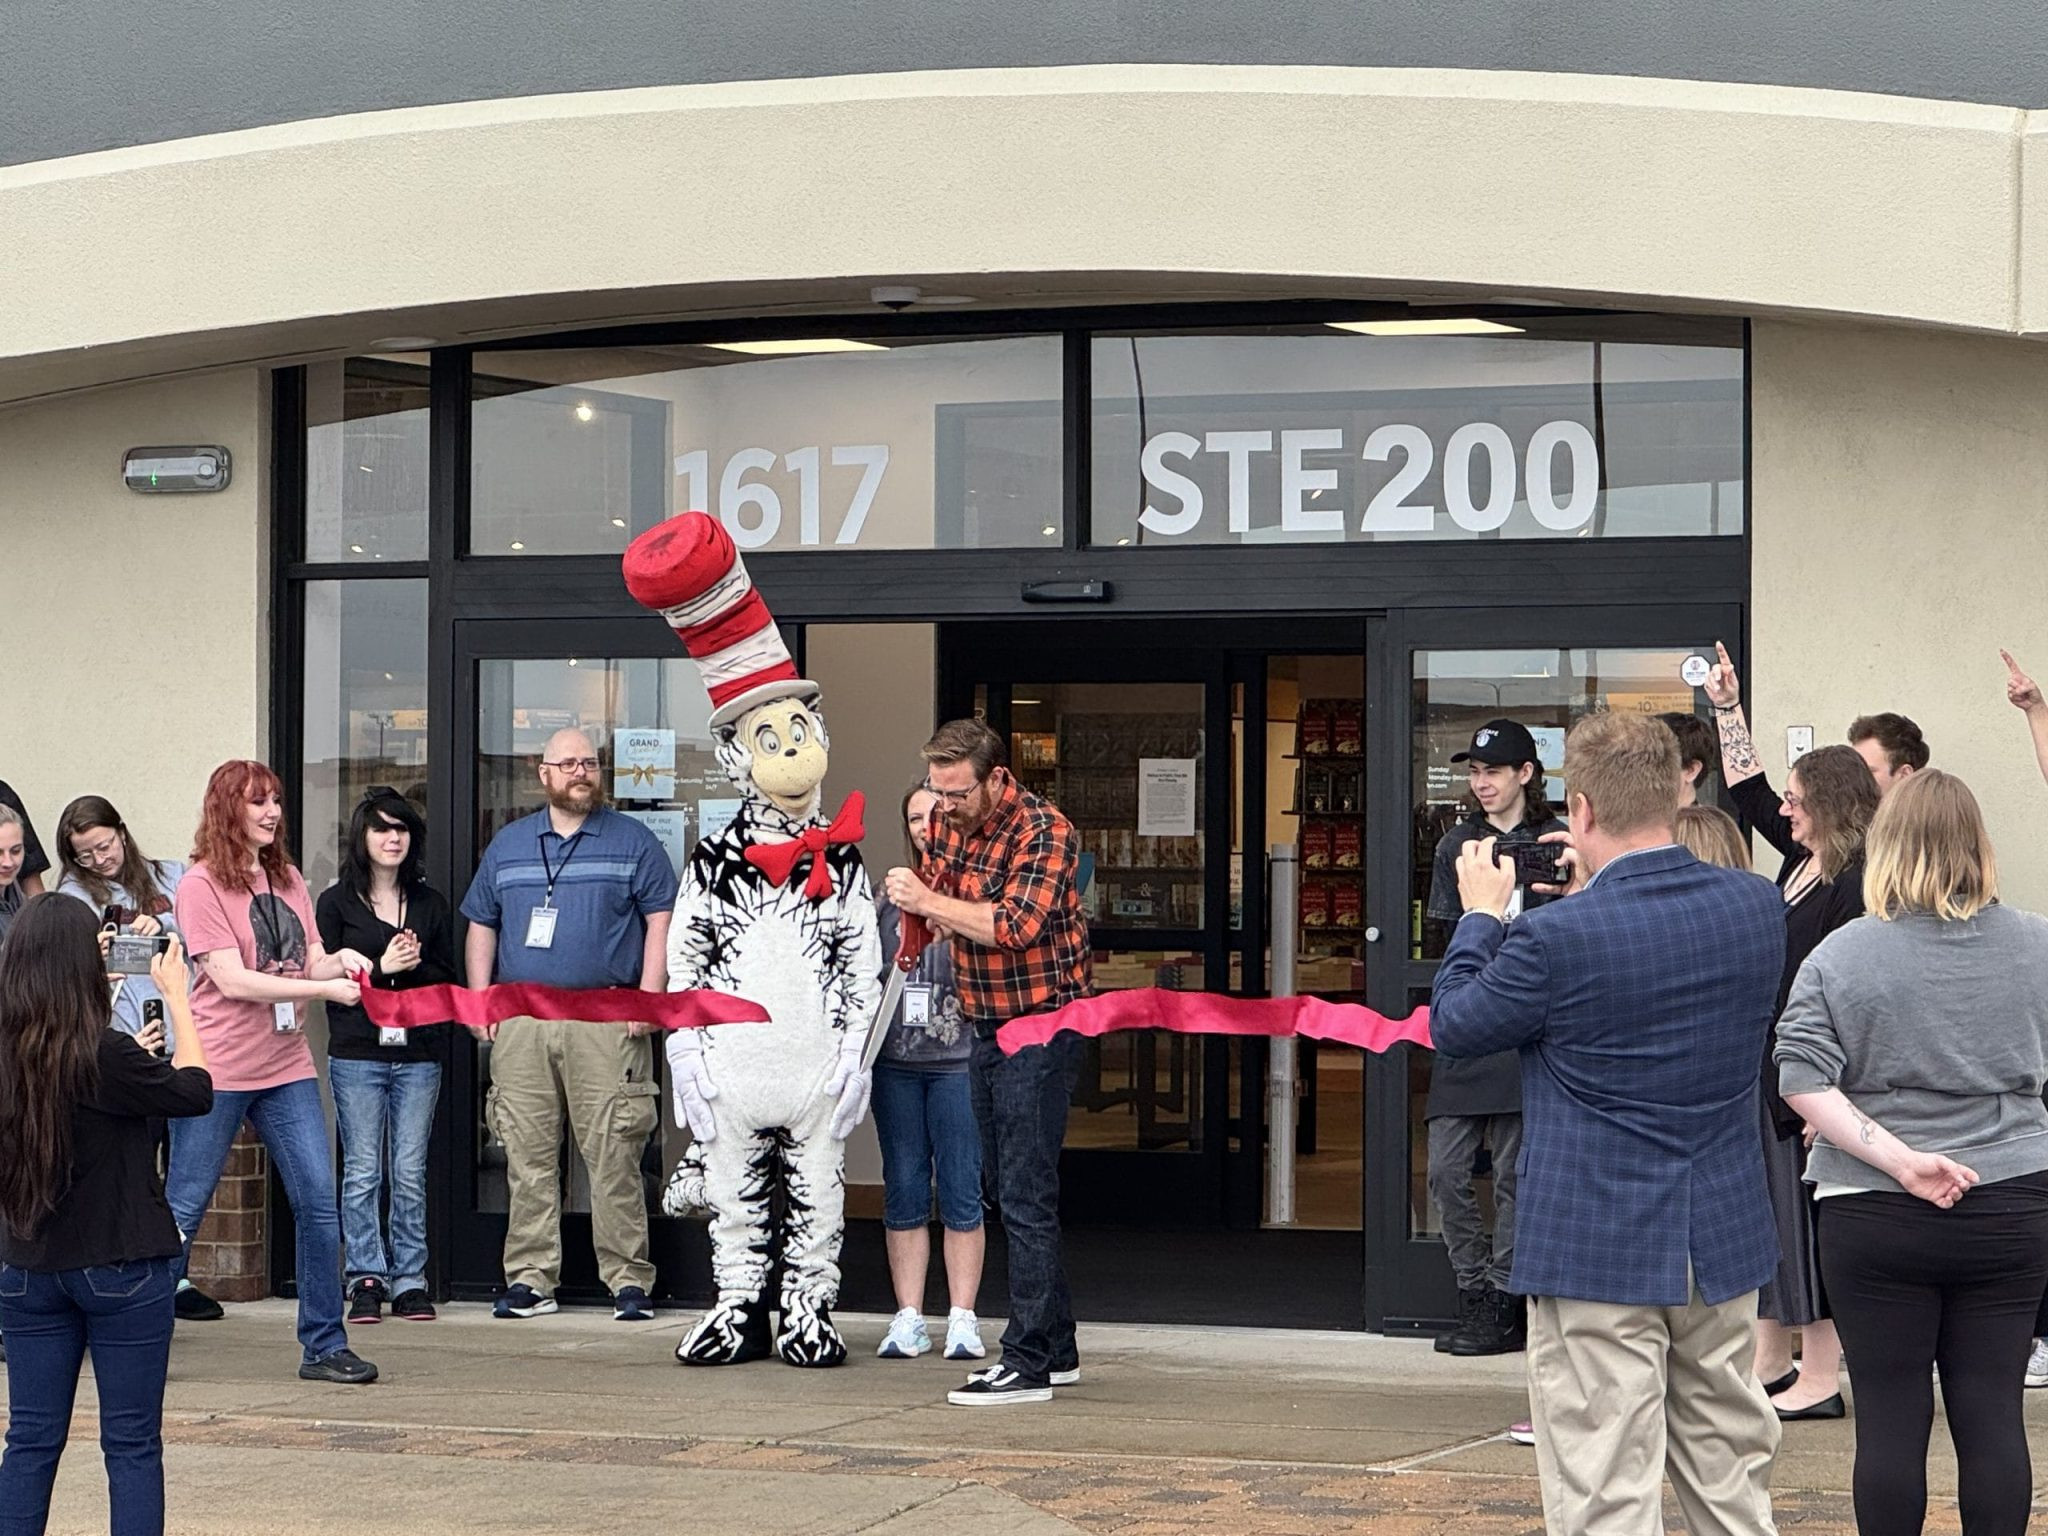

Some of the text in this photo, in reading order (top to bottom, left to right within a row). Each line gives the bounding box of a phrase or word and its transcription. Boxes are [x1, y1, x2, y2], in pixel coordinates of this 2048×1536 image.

[674, 445, 889, 548] 1617
[1138, 420, 1599, 535] STE 200
[629, 739, 659, 747] GRAND
